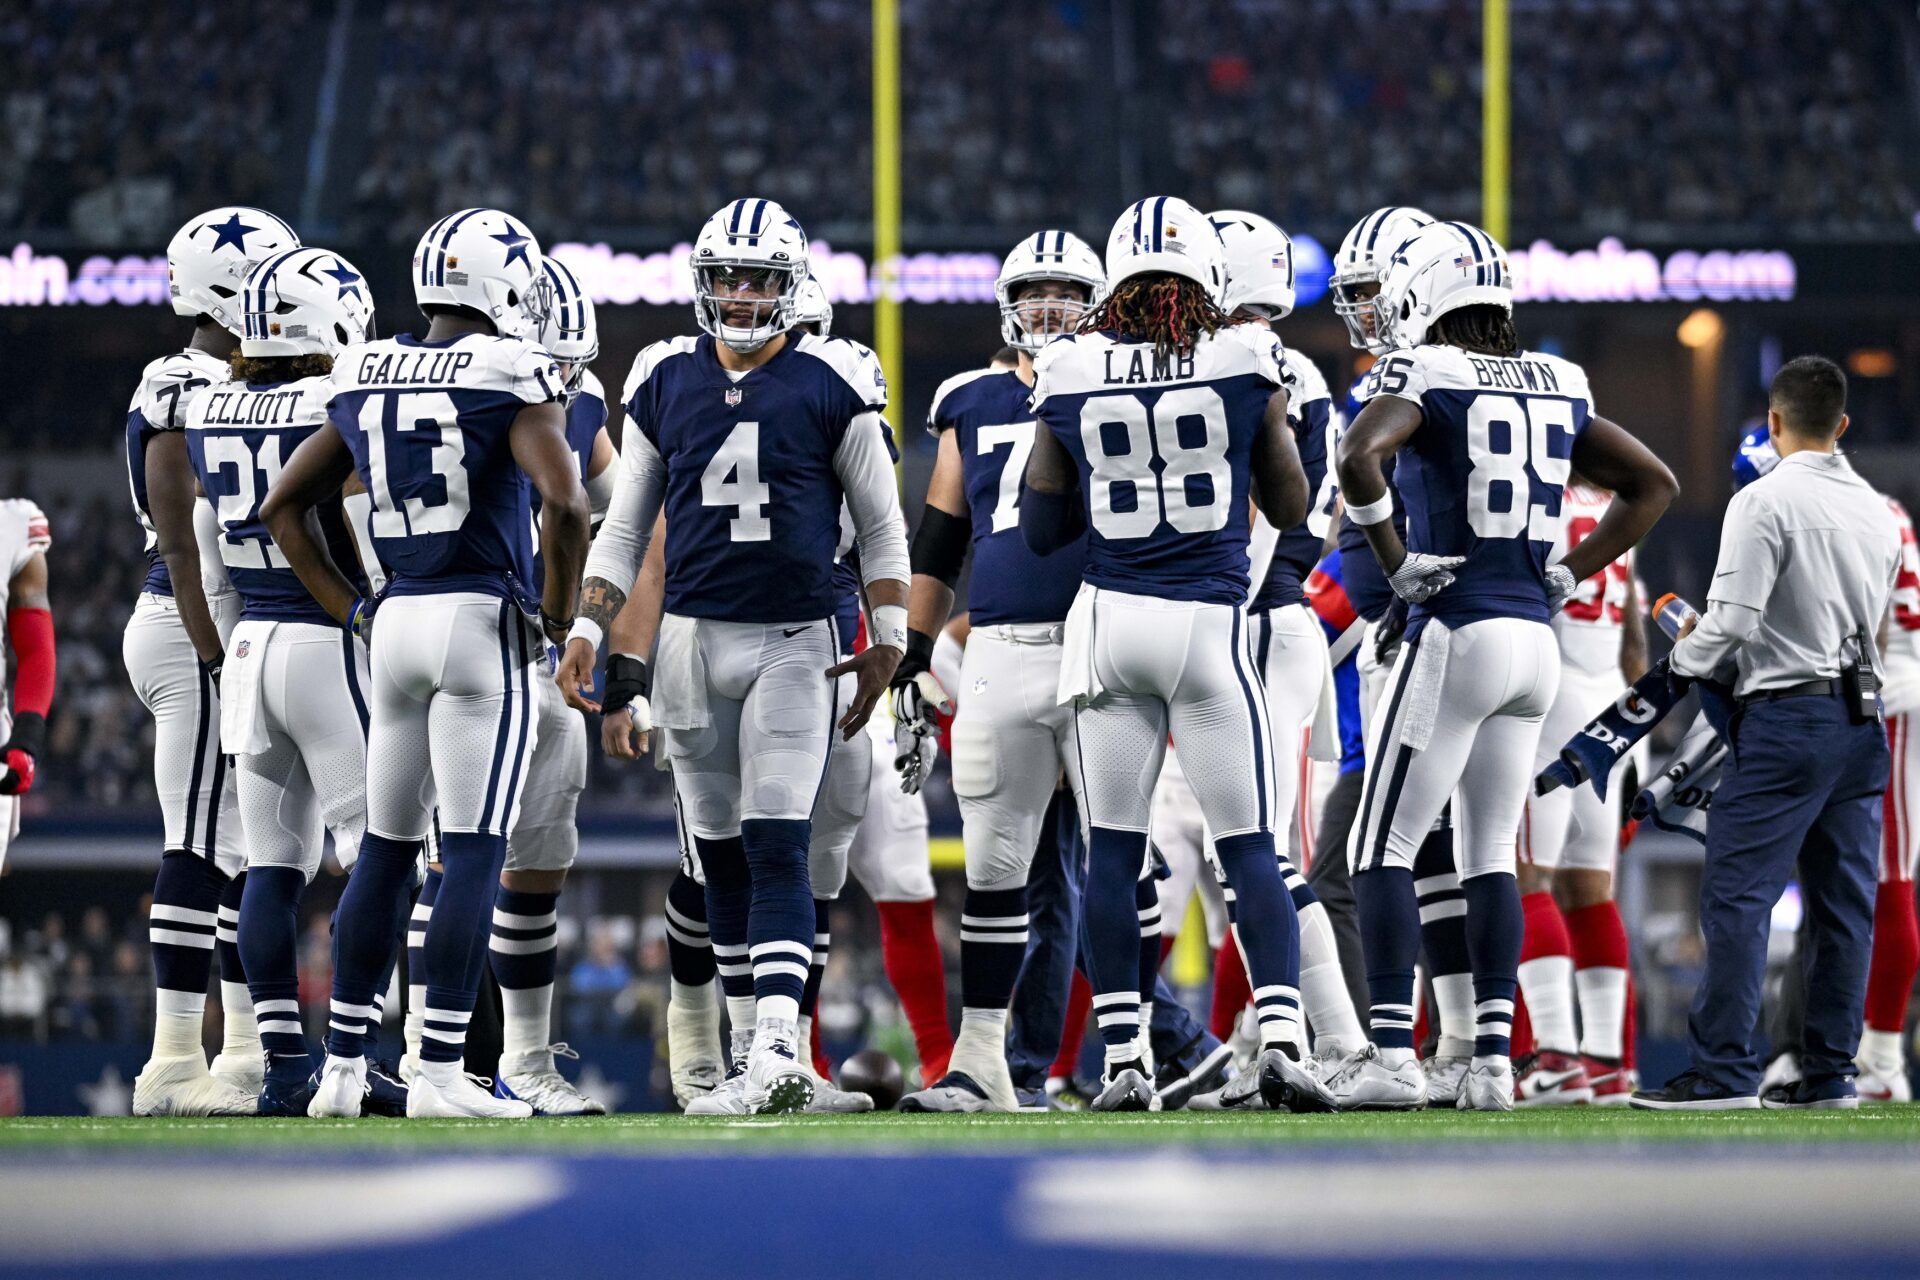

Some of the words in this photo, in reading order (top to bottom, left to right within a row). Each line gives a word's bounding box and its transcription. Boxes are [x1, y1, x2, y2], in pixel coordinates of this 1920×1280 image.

[357, 352, 473, 385] GALLUP
[1104, 350, 1195, 384] LAMB
[1367, 357, 1415, 394] 85
[1467, 357, 1560, 393] BROWN
[203, 390, 305, 425] ELLIOTT
[203, 434, 293, 569] 21
[358, 391, 471, 537] 13
[700, 421, 771, 542] 4
[1080, 386, 1232, 539] 88
[1467, 394, 1576, 542] 85
